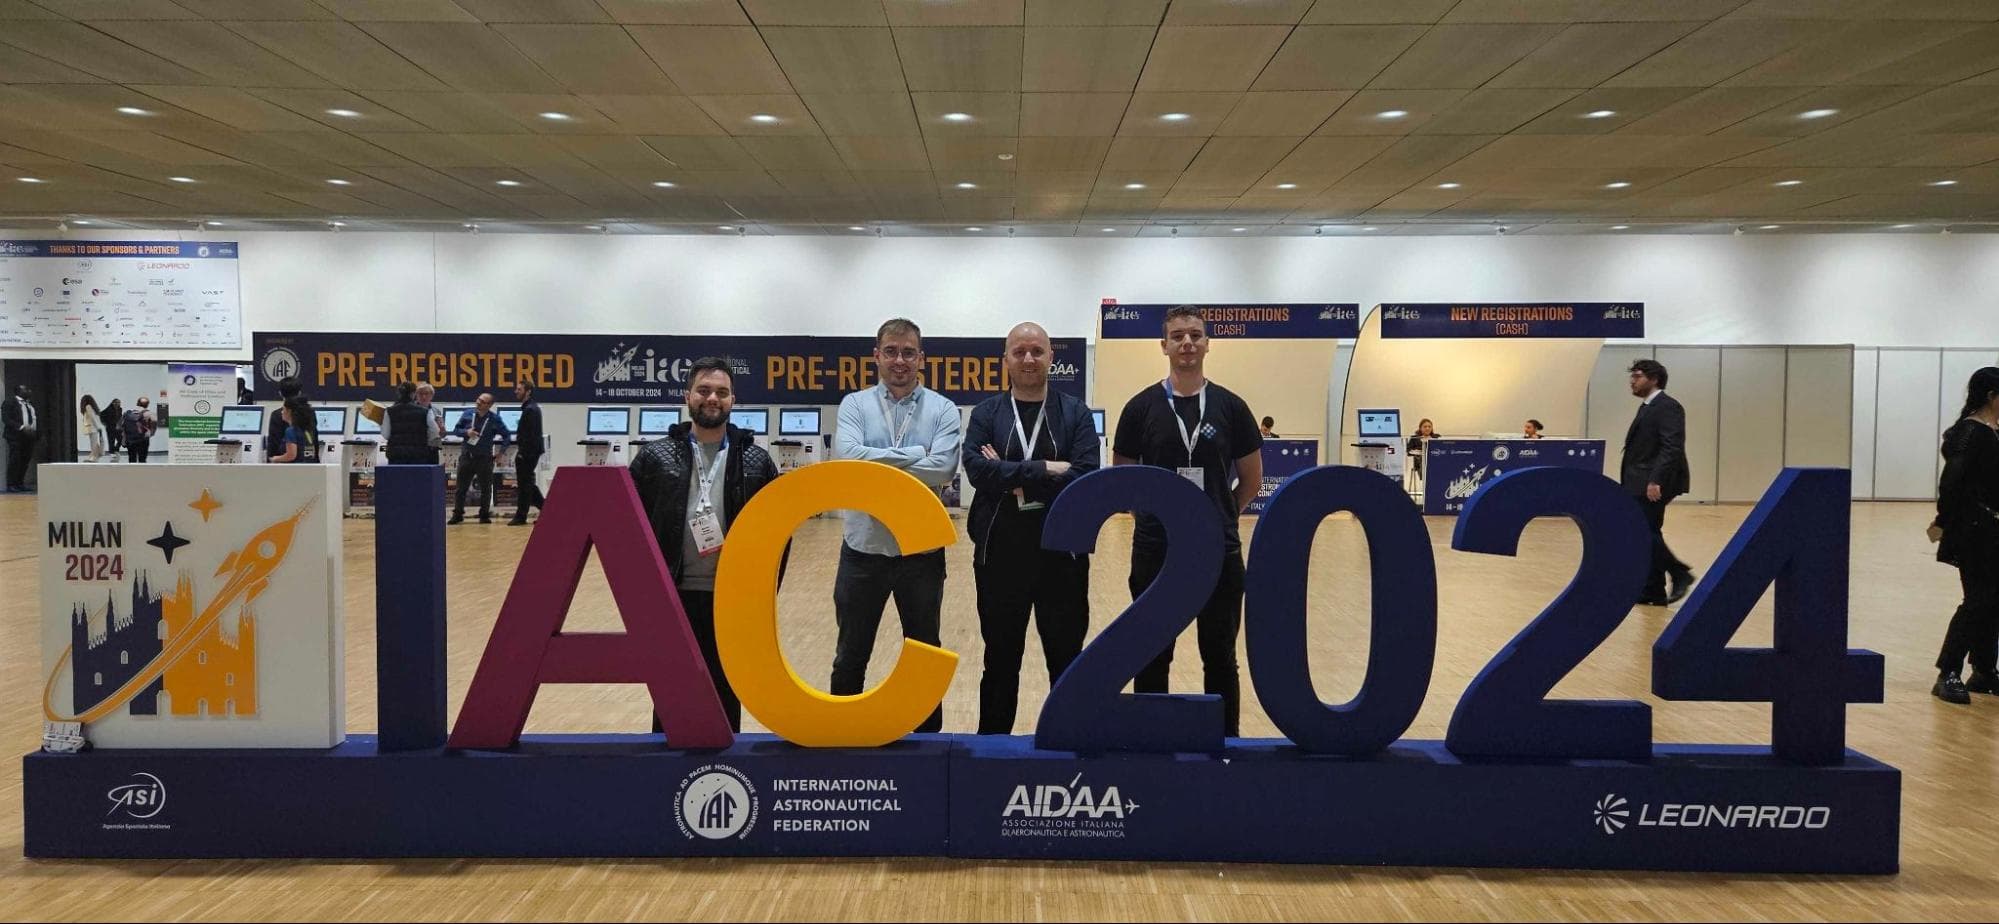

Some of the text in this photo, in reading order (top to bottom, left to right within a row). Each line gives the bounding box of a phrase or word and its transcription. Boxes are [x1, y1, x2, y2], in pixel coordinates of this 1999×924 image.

[50, 245, 75, 254] THANKS
[77, 245, 85, 254] TO
[87, 245, 100, 254] OUR
[102, 245, 137, 254] SPONSORS
[144, 246, 180, 254] PARTNERS
[1451, 307, 1573, 321] NEW REGISTRATIONS
[317, 352, 574, 388] PRE-REGISTERED
[616, 388, 645, 397] OCTOBER
[645, 388, 661, 397] 2024
[48, 521, 122, 549] MILAN
[65, 554, 124, 581] 2024
[375, 460, 1885, 765] IAC 2024
[689, 764, 712, 779] PACEM
[773, 779, 898, 792] INTERNATIONAL
[699, 791, 737, 829] IAF
[772, 799, 902, 812] ASTRONAUTICAL
[1638, 803, 1831, 829] LEONARDO
[773, 819, 870, 832] FEDERATION
[1002, 819, 1125, 829] ASSOCIAZIONE ITALIANA
[1070, 830, 1125, 838] ASTRONAUTICA
